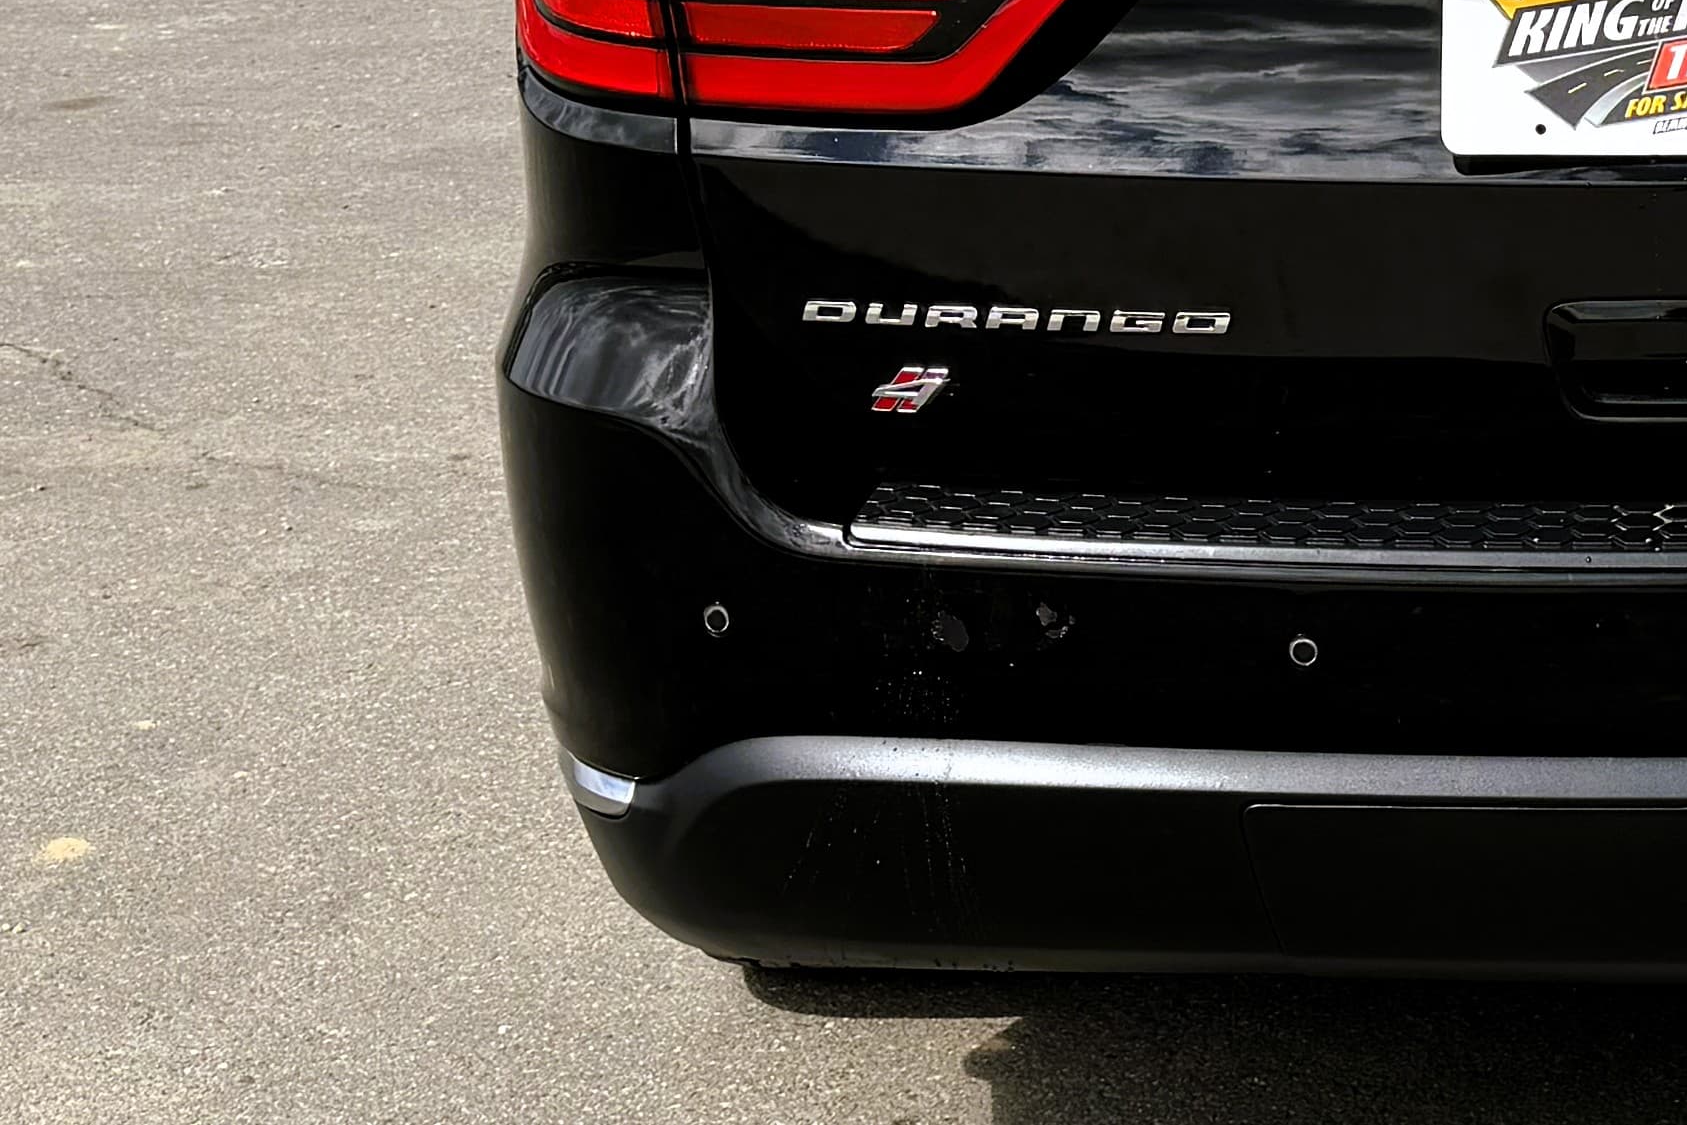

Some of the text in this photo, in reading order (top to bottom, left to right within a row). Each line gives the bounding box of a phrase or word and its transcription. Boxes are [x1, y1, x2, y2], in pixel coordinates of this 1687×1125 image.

[1637, 15, 1673, 37] THE
[1625, 95, 1667, 118] FOR
[802, 301, 1231, 334] DURANGO
